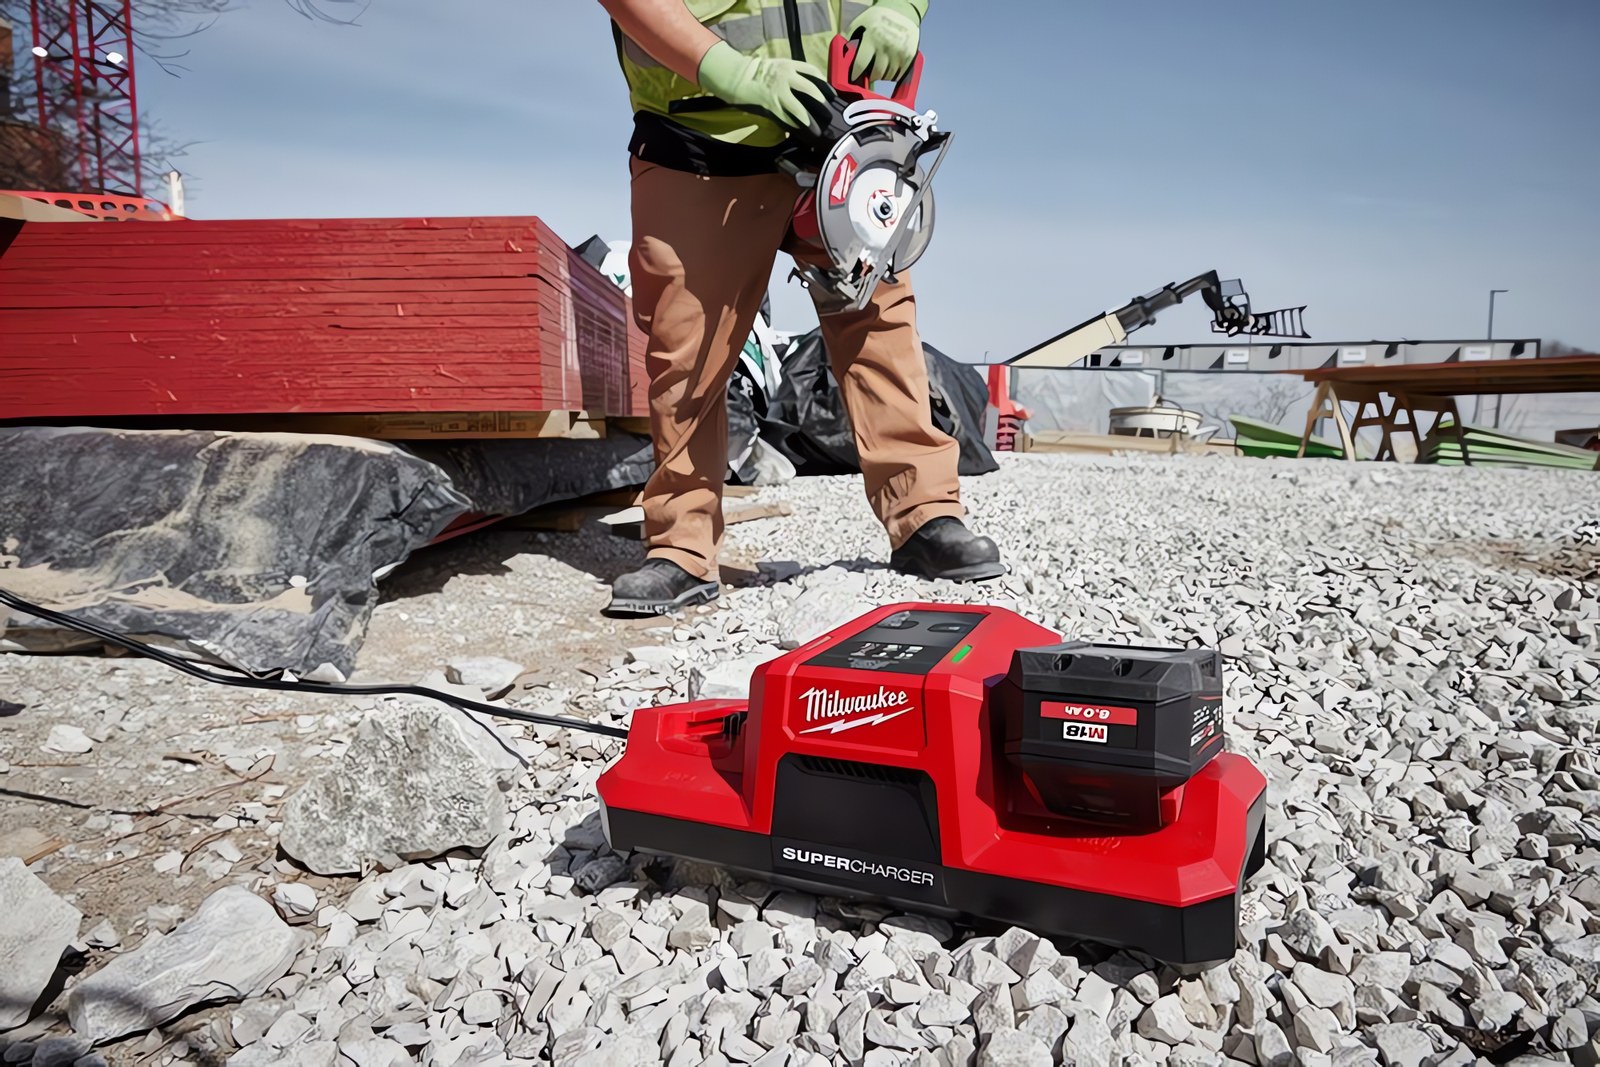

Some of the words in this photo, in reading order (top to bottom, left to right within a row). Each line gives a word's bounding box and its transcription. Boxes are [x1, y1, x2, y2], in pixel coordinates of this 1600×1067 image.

[799, 686, 908, 721] Milwaukee
[1066, 725, 1105, 739] M18
[782, 847, 934, 886] SUPERCHARGER
